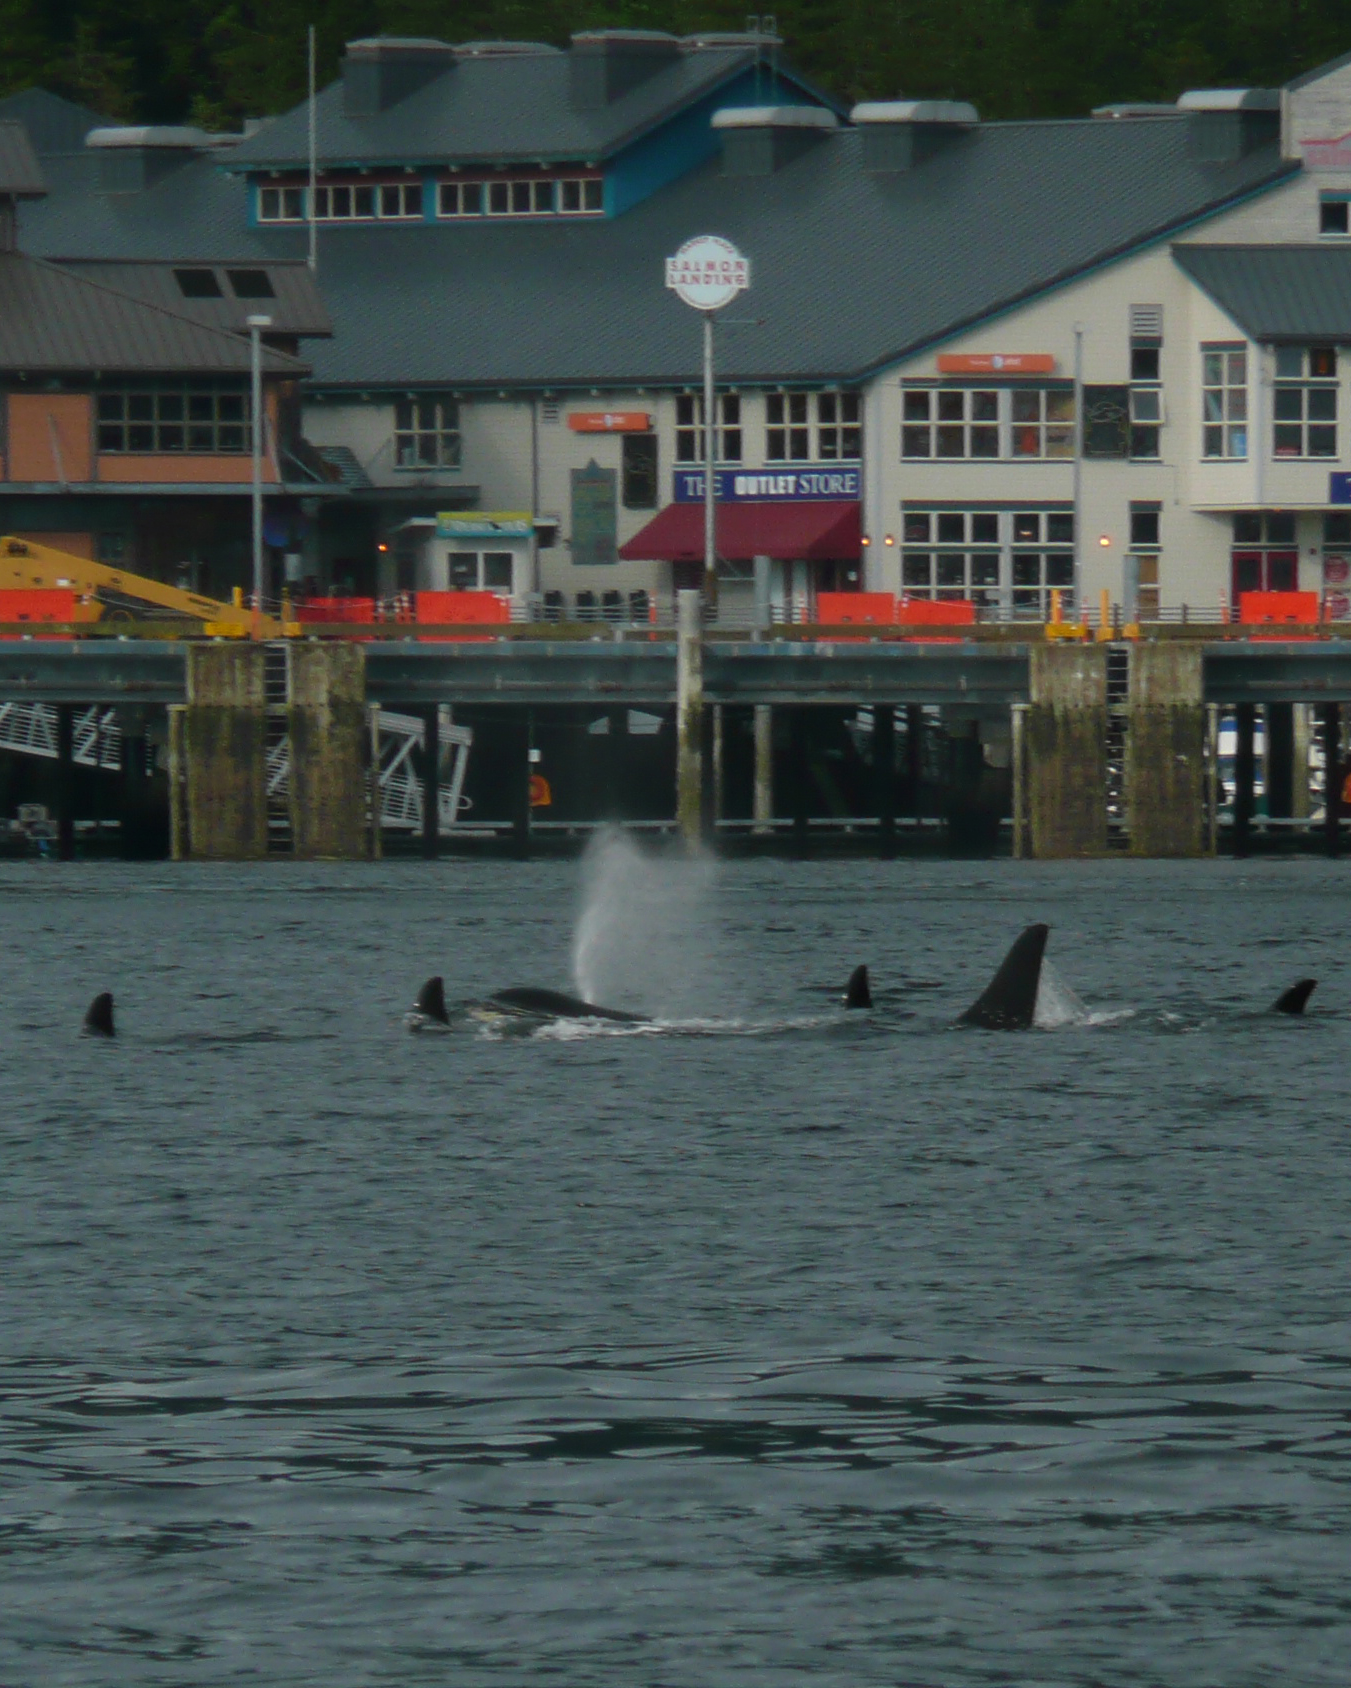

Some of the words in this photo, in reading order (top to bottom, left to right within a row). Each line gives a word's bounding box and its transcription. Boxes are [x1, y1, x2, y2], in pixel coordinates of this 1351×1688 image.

[670, 260, 745, 272] SALMON
[669, 273, 746, 285] LANDING
[684, 476, 723, 496] THE
[734, 474, 796, 495] OUTLET
[799, 473, 857, 494] STORE
